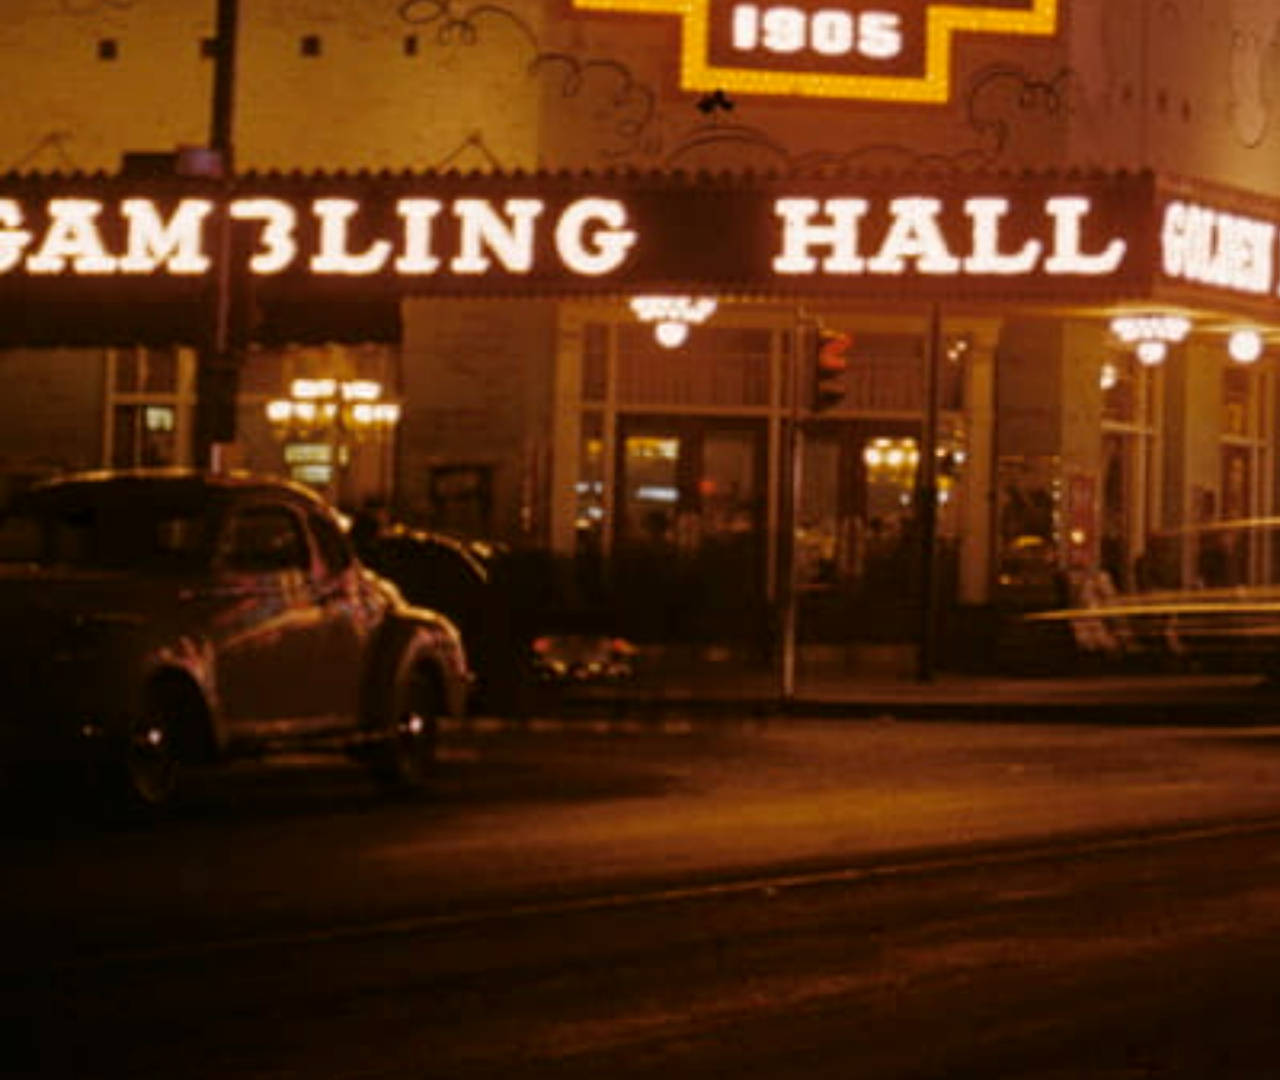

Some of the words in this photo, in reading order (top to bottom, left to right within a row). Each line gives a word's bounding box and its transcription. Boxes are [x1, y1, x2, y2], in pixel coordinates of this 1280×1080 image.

[731, 3, 903, 60] 1905
[772, 197, 1126, 275] HALL
[1160, 199, 1276, 295] GOLDEN
